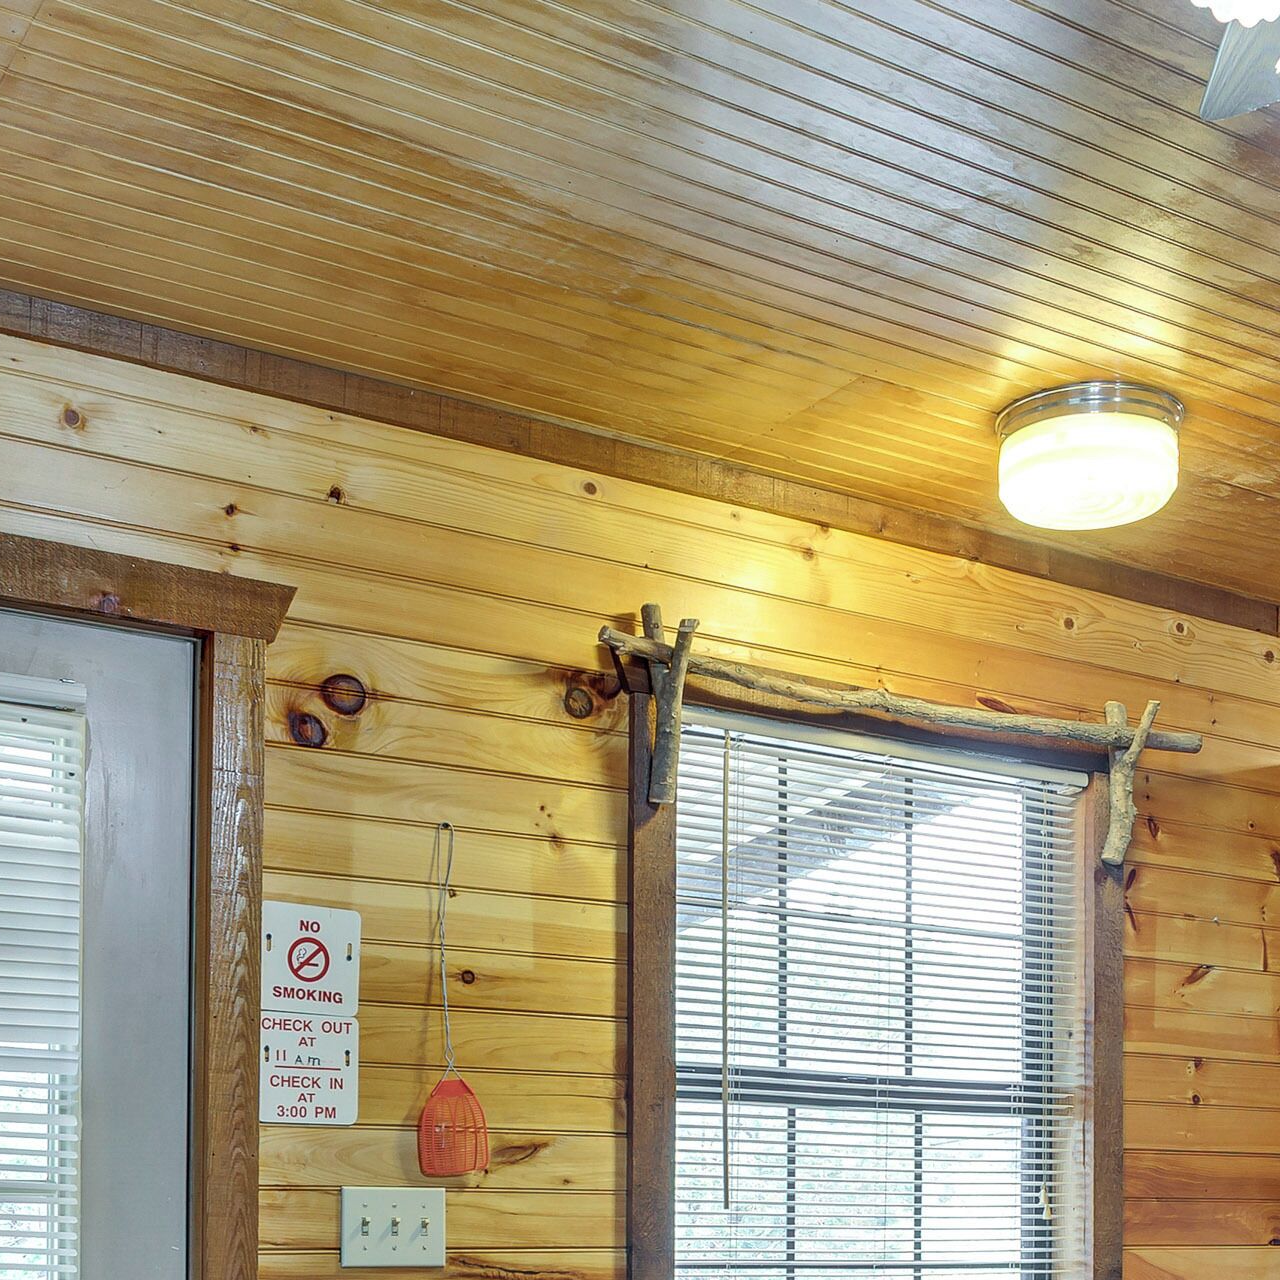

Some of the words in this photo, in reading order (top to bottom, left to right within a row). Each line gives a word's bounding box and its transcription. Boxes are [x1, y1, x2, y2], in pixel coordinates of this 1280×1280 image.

[299, 919, 320, 933] NO
[272, 986, 343, 1004] SMOKING
[261, 1018, 313, 1032] CHECK
[321, 1021, 352, 1034] OUT
[298, 1037, 316, 1047] AT
[270, 1075, 320, 1089] CHECK
[329, 1077, 344, 1090] IN
[297, 1093, 316, 1103] AT
[277, 1105, 307, 1118] 3:00
[314, 1106, 336, 1119] PM
